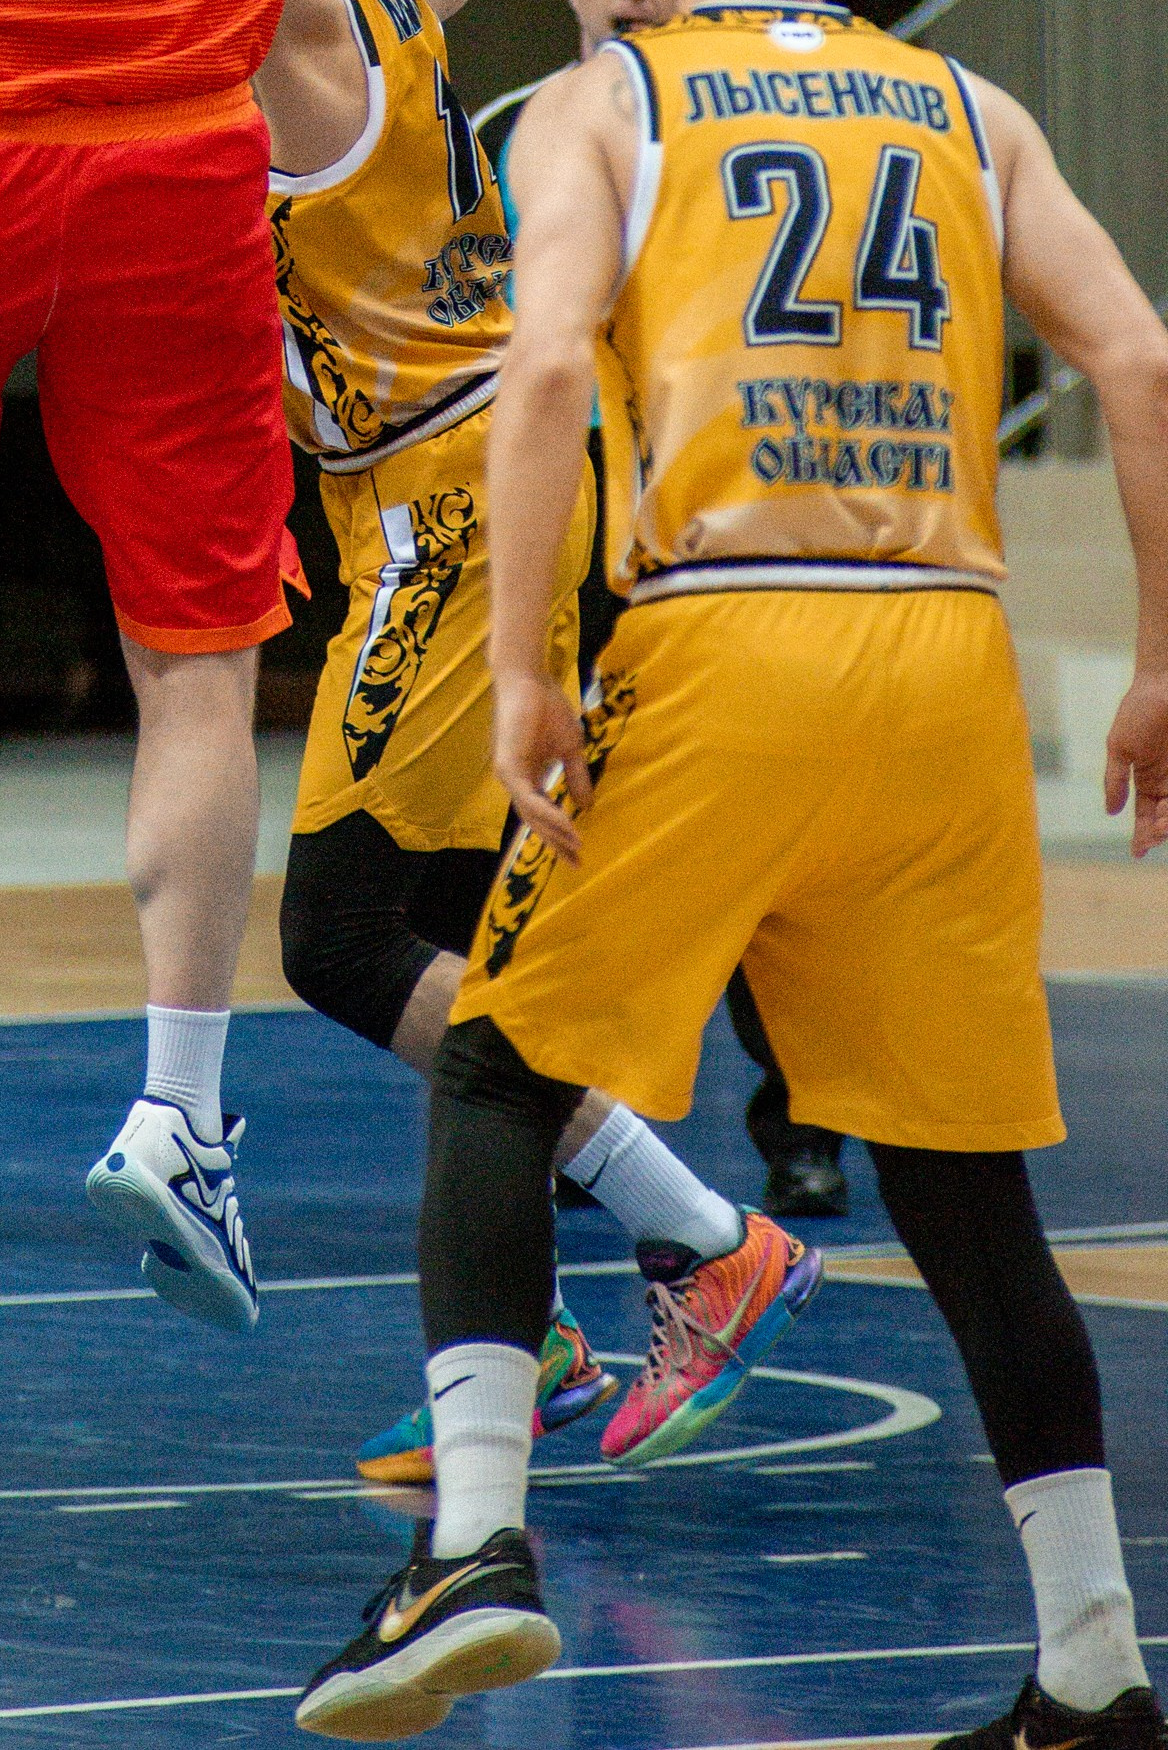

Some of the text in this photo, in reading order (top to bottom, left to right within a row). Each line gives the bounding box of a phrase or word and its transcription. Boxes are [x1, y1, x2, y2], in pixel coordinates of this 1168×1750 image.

[434, 54, 497, 225] 1
[682, 67, 953, 134] ЛЫСЕНКОВ
[721, 140, 951, 353] 24
